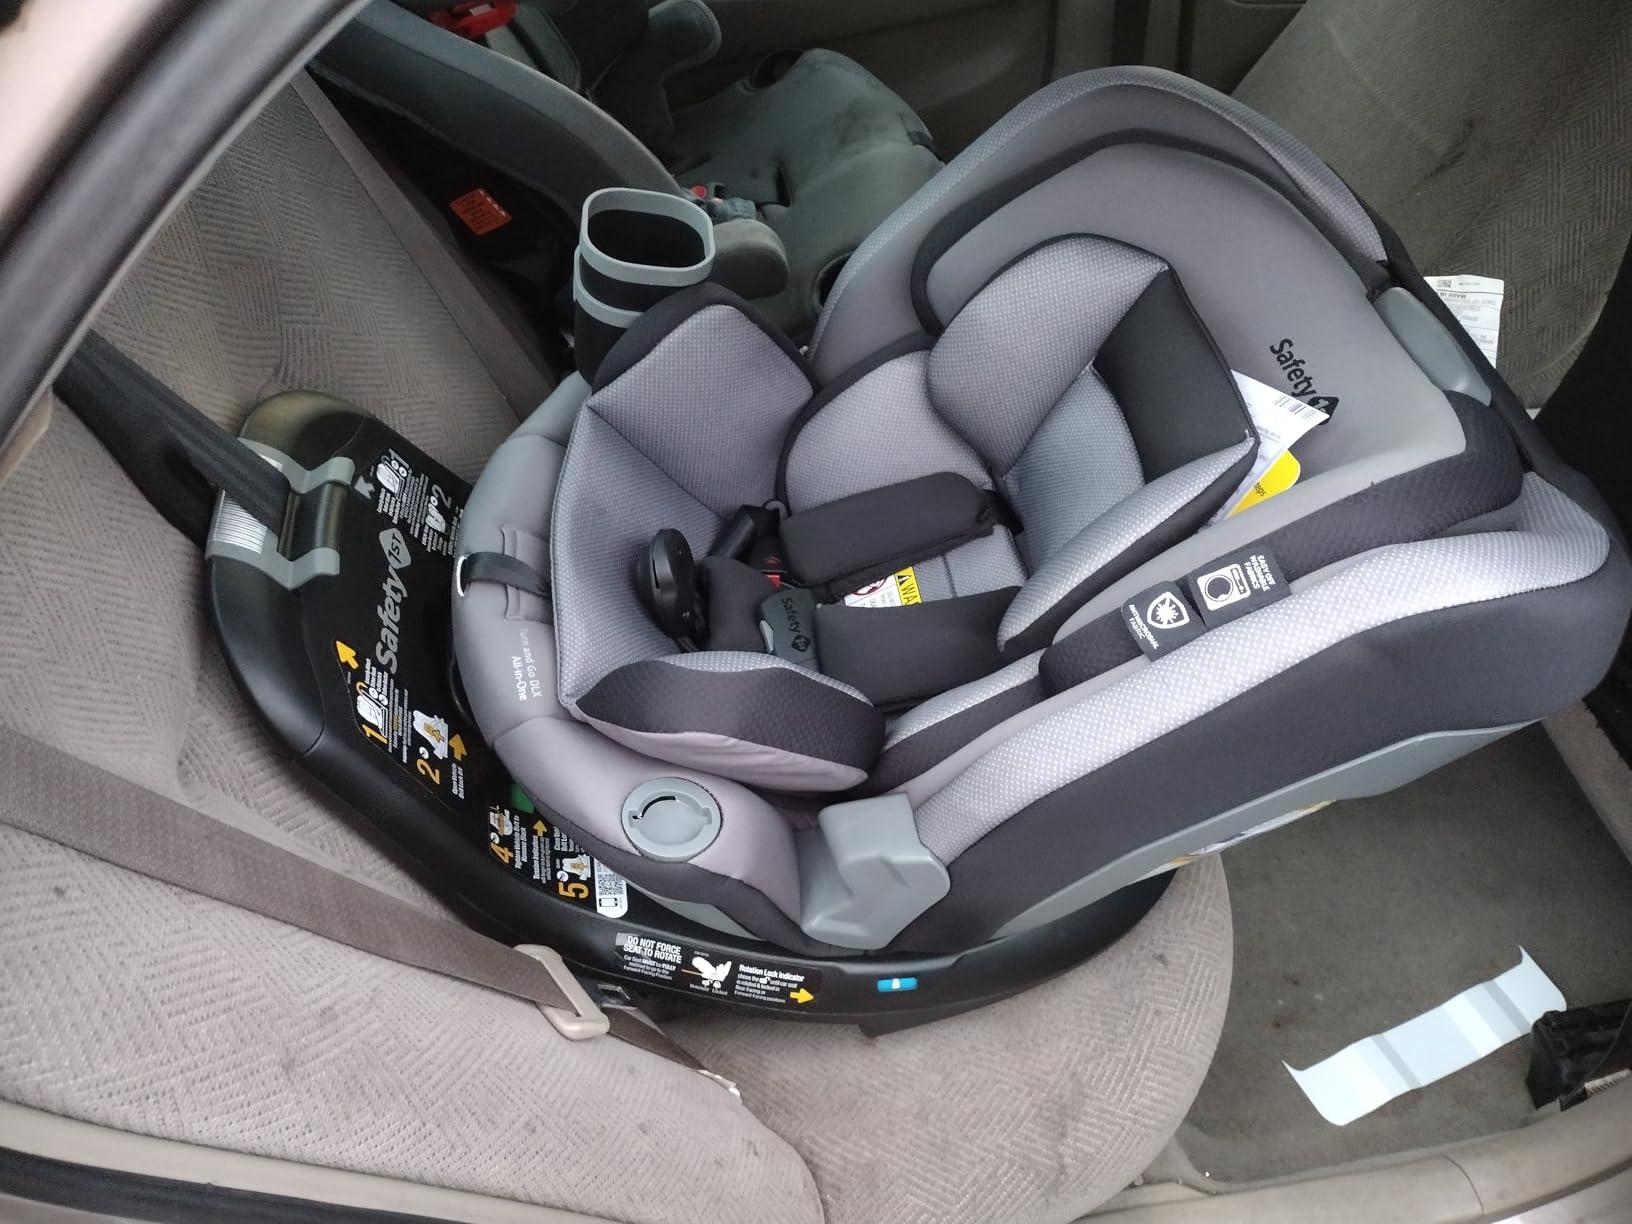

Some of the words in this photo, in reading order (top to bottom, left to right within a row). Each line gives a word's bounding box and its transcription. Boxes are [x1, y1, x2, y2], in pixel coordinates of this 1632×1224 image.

[1270, 338, 1317, 398] Safety
[389, 448, 410, 469] 1
[432, 484, 452, 509] 2
[388, 532, 403, 565] 1ST
[1244, 561, 1261, 590] FABRICS
[1250, 555, 1270, 592] WASHABLE
[1257, 555, 1269, 575] EASY
[1265, 573, 1276, 586] OFF
[375, 564, 408, 675] Safety
[781, 597, 801, 633] Safety
[1128, 604, 1160, 650] ANTIMICROBIAL
[1128, 617, 1146, 640] FABRIC
[523, 647, 535, 664] and
[511, 656, 528, 702] All-in-One
[527, 665, 537, 678] Go
[530, 679, 543, 697] DLX
[362, 724, 388, 745] 1
[416, 759, 440, 784] 2
[491, 842, 514, 864] 4
[559, 882, 589, 899] 5
[623, 943, 645, 954] SEAT
[643, 947, 653, 957] TO
[653, 950, 682, 964] ROTATE
[627, 935, 638, 945] DO
[640, 938, 656, 948] NOT
[656, 941, 682, 955] FORCE
[642, 958, 656, 967] MUST
[662, 963, 676, 971] FULLY
[739, 964, 764, 975] Rotation
[764, 969, 778, 978] Lock
[779, 971, 805, 982] Indicator
